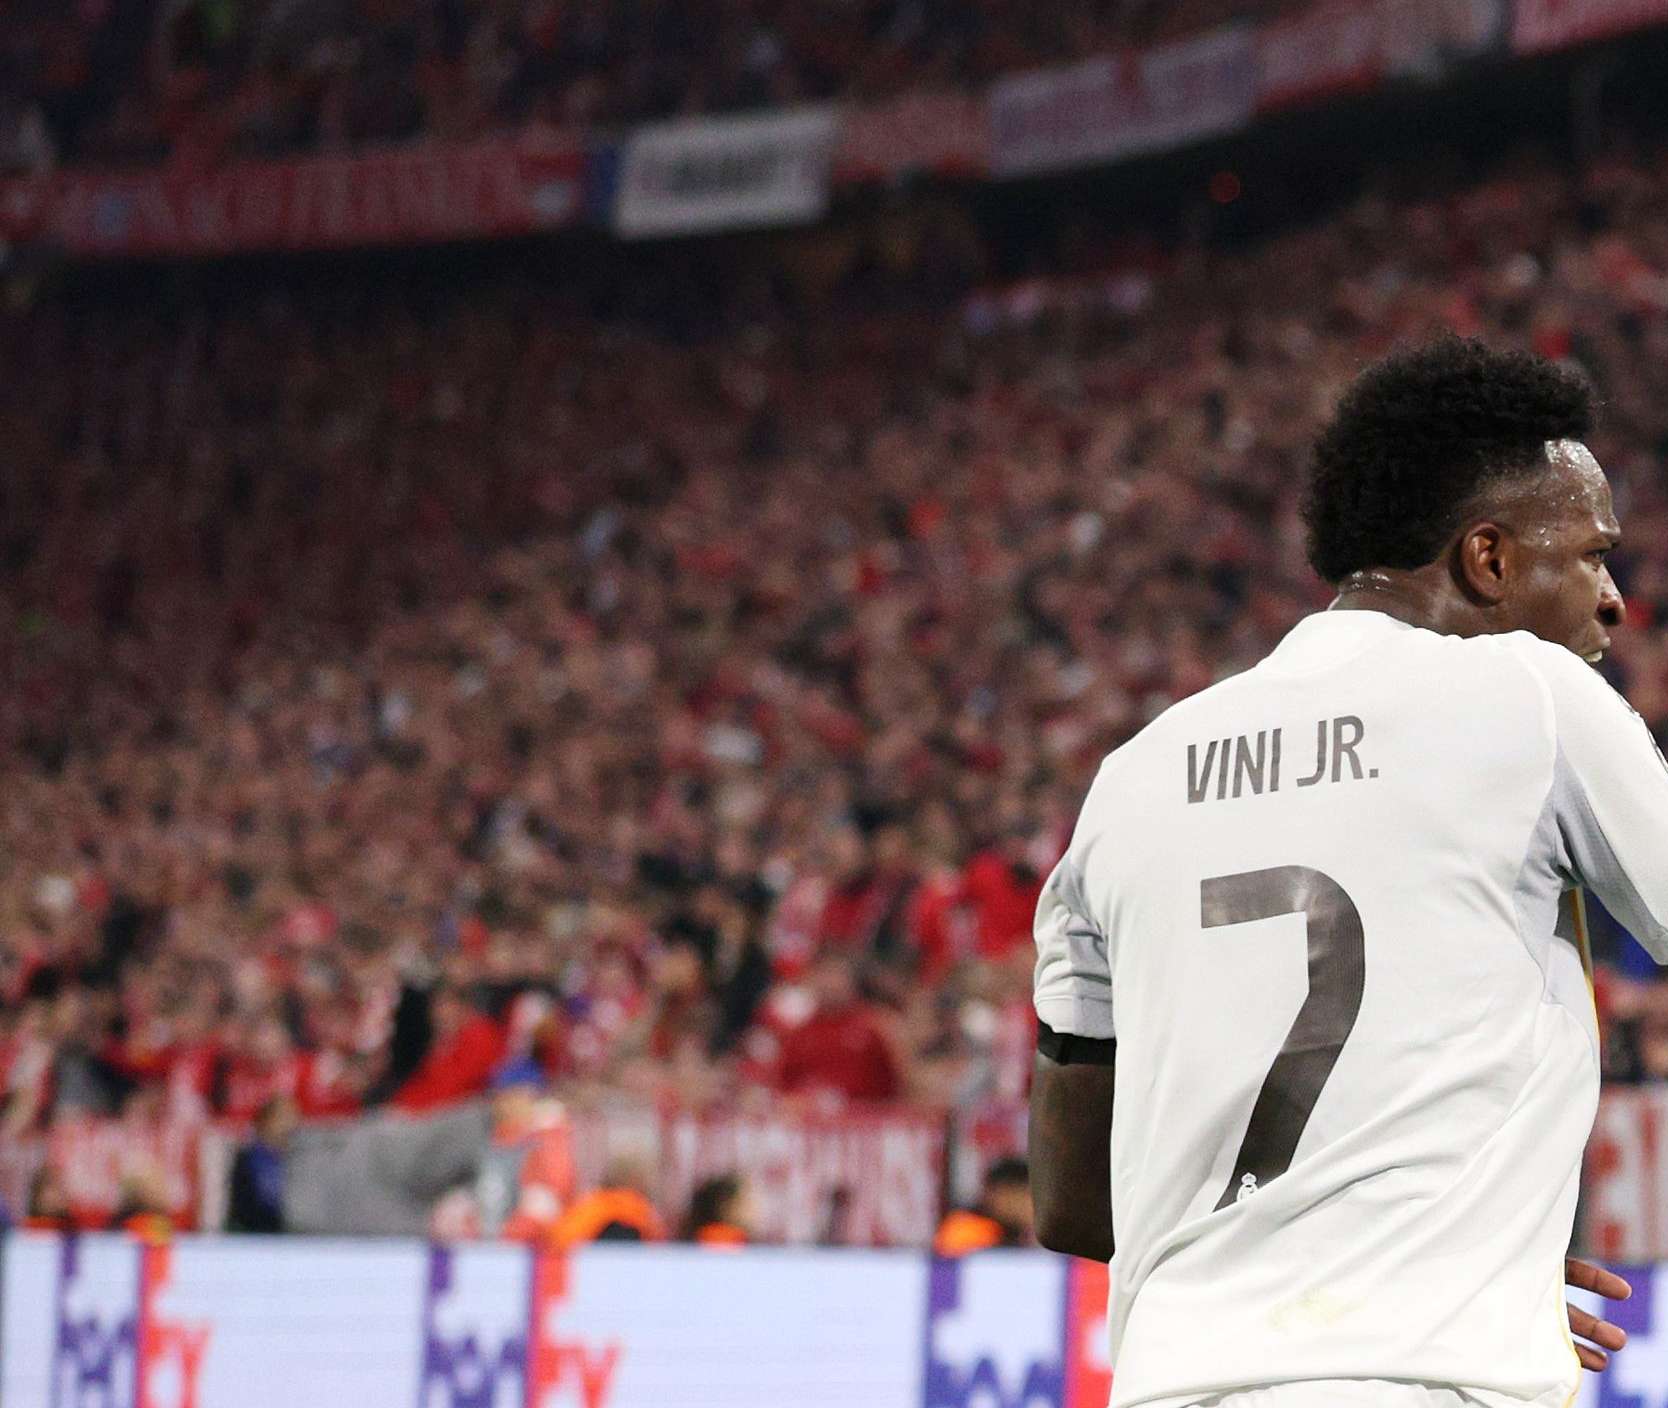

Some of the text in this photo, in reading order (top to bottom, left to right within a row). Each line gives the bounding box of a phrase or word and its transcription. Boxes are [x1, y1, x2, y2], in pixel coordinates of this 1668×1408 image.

[1187, 715, 1380, 804] VINI JR.
[1200, 864, 1366, 1212] 7
